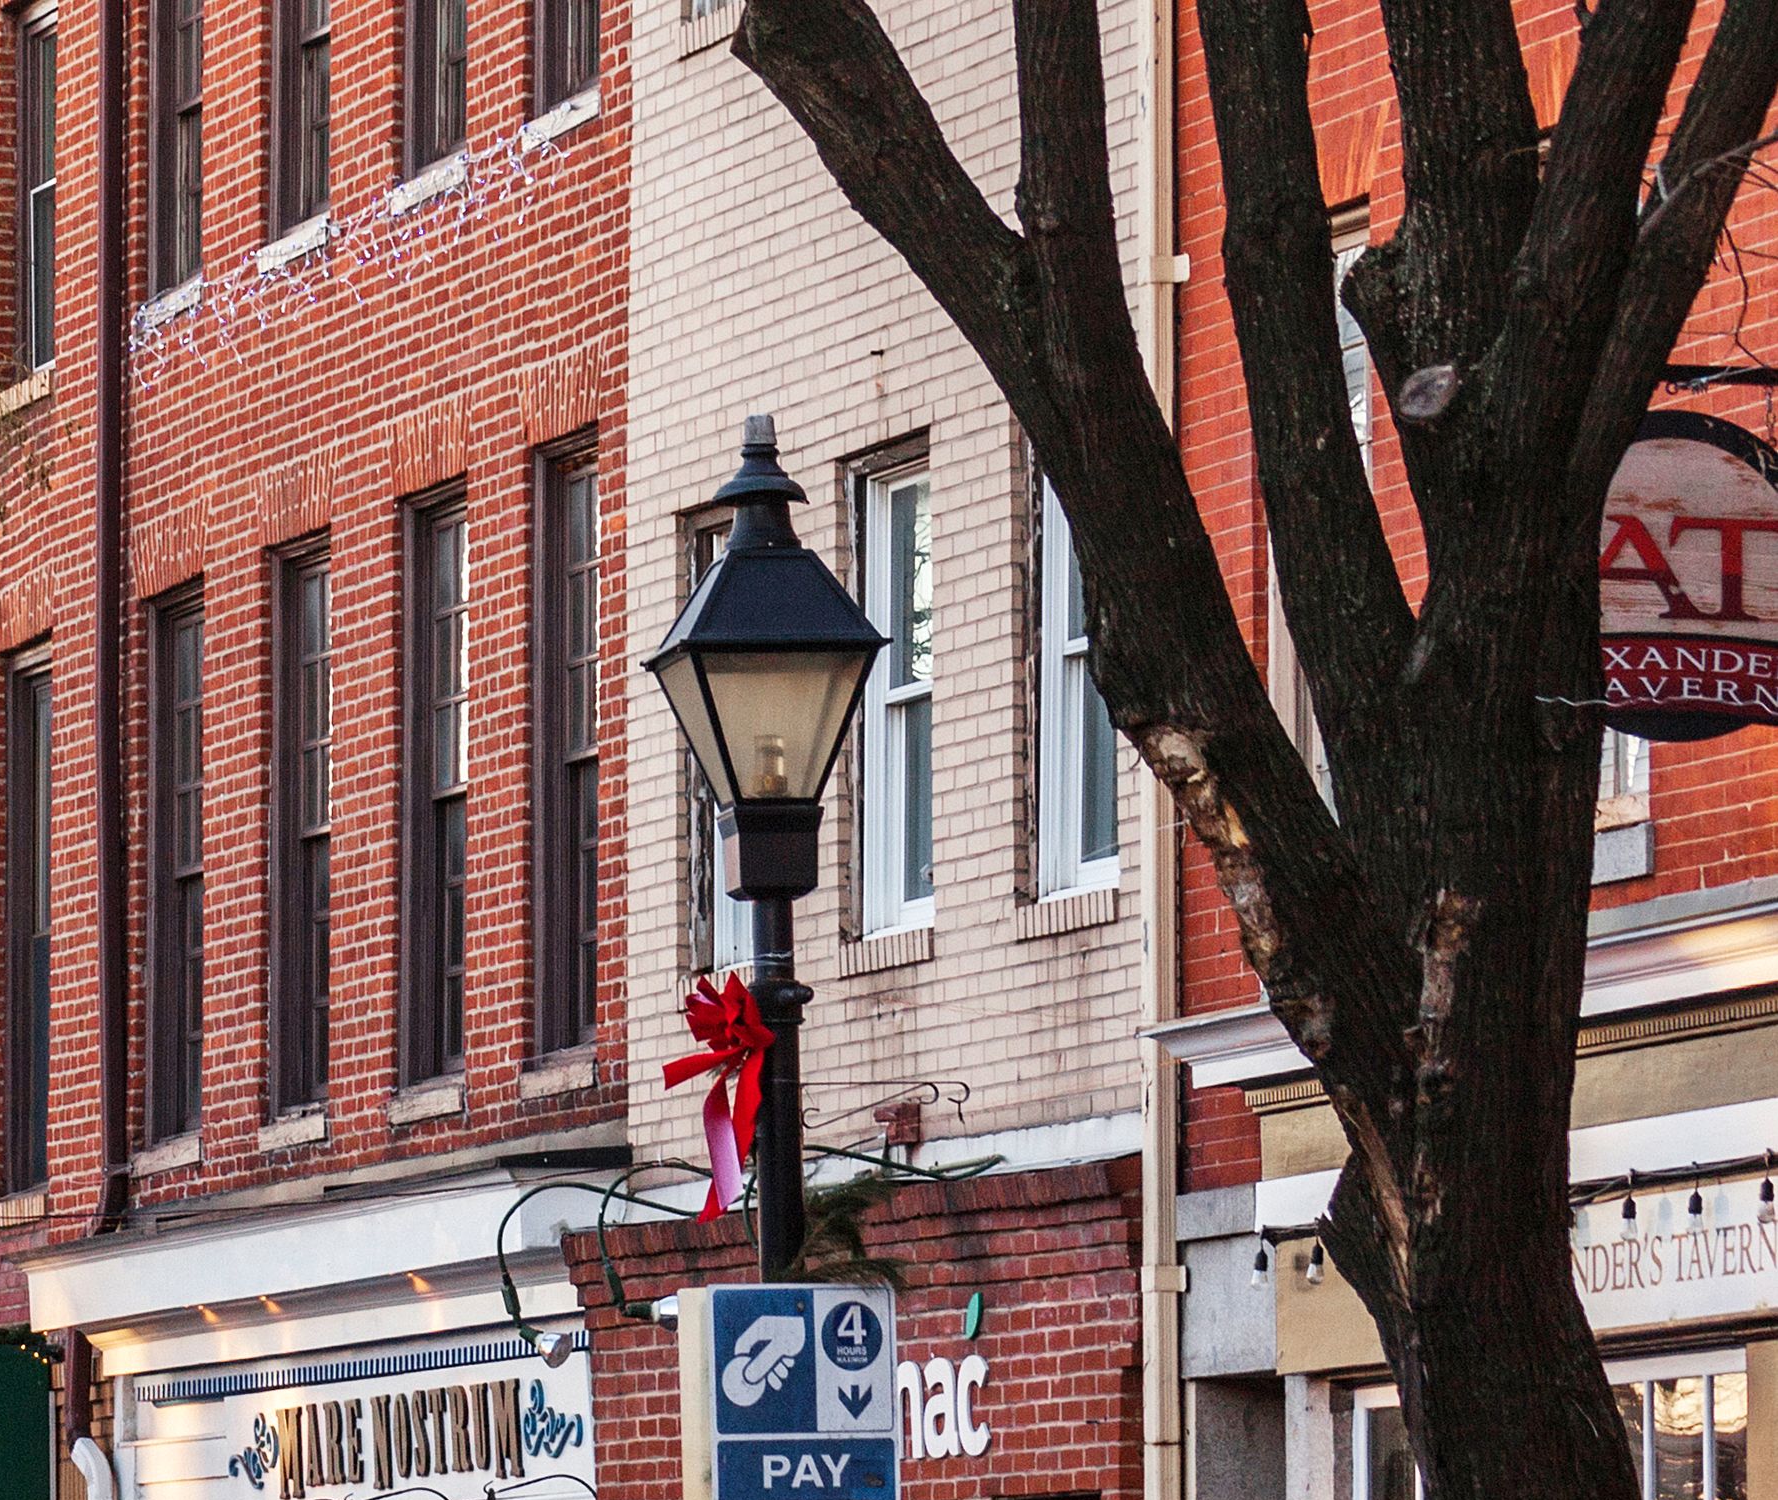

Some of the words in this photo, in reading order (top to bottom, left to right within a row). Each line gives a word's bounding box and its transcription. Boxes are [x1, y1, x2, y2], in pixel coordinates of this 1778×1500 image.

[1602, 646, 1778, 679] XANDE
[1605, 677, 1778, 709] AVERN
[1570, 1233, 1663, 1294] NDER'S
[837, 1304, 867, 1345] 4
[836, 1346, 867, 1356] HOURS
[276, 1398, 365, 1500] MARE
[370, 1378, 526, 1491] NOSTRUM
[762, 1453, 851, 1489] PAY
